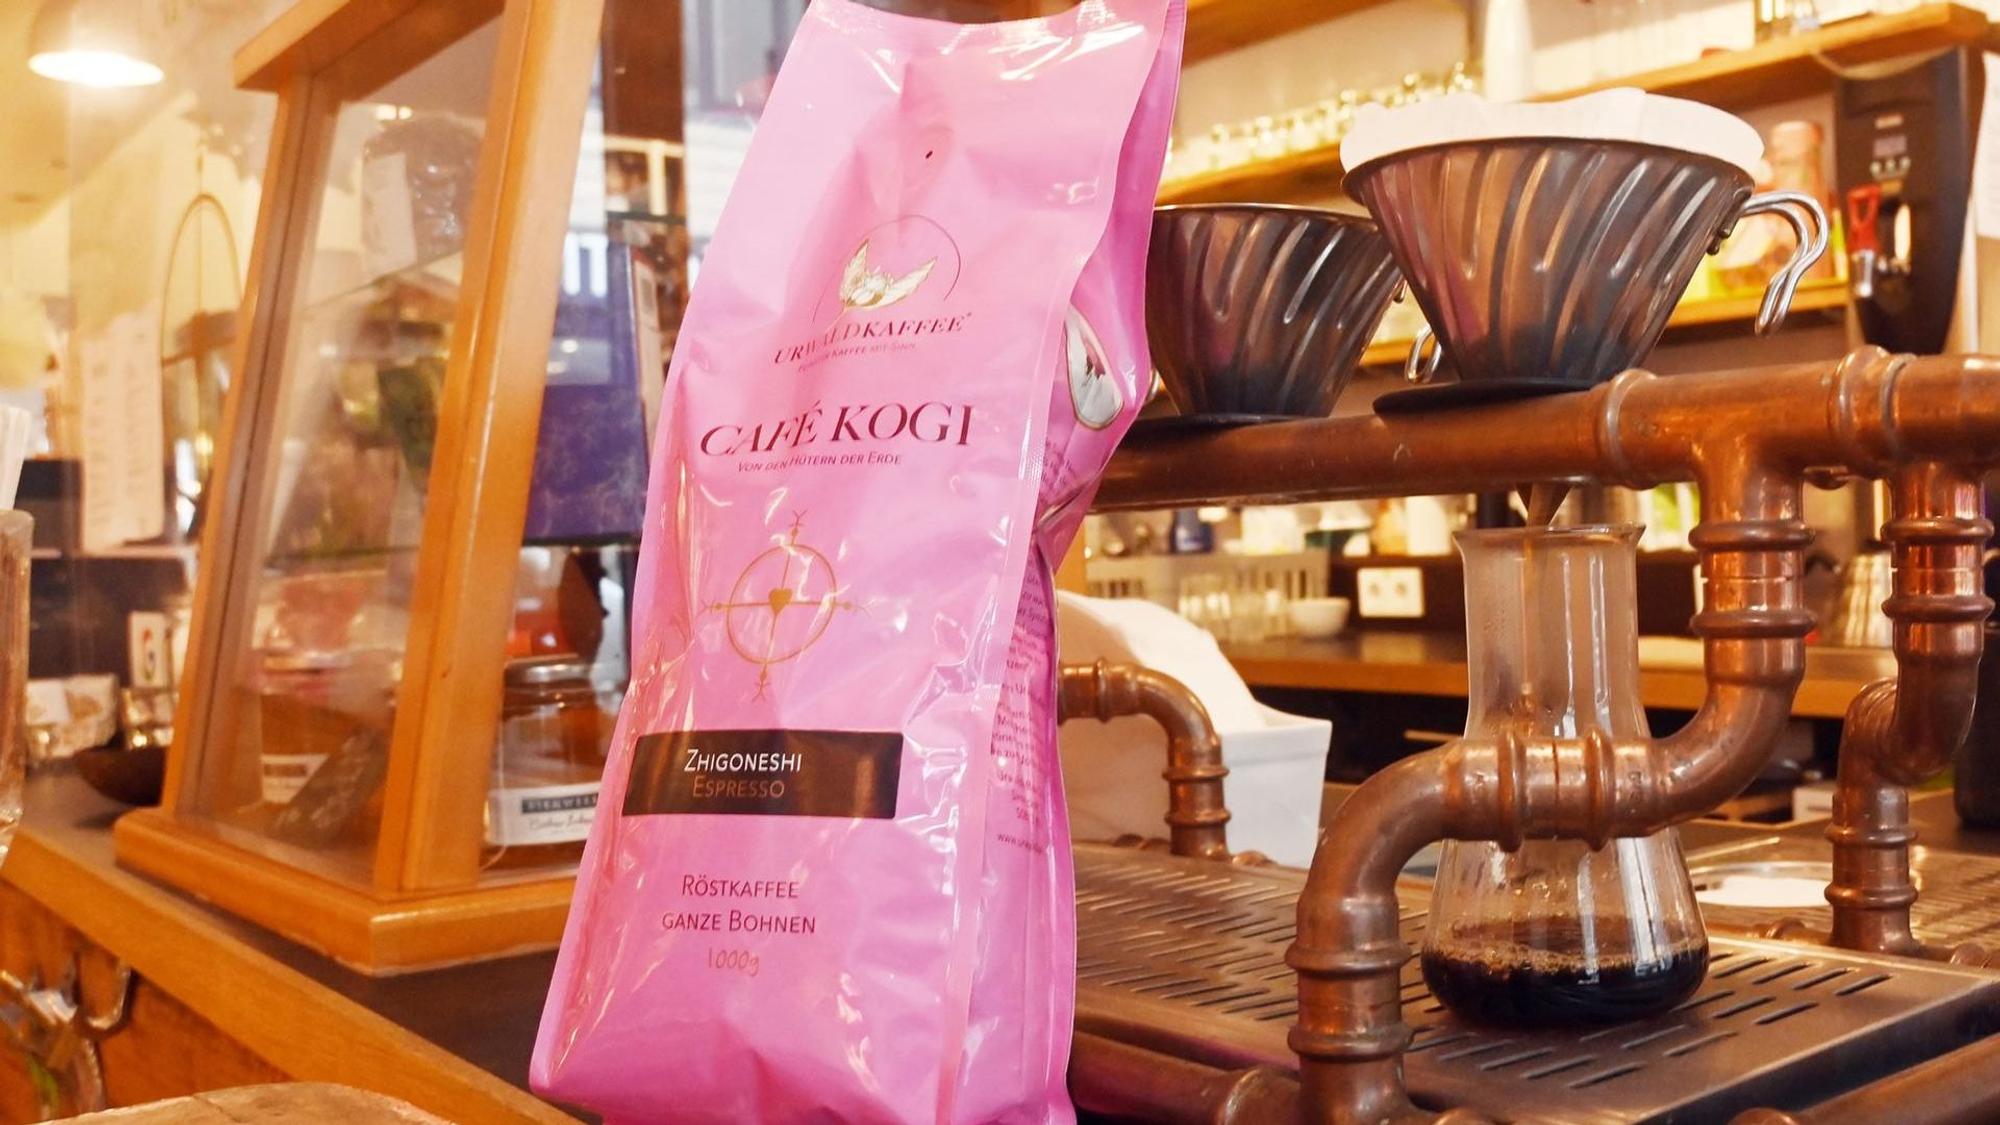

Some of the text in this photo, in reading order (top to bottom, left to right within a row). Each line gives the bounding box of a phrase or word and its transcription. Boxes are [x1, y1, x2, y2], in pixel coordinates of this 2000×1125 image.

[700, 400, 975, 457] CAFÉ KOGI
[737, 461, 762, 473] VON
[839, 453, 864, 465] DER
[867, 450, 902, 466] ERDE
[684, 748, 802, 773] ZHIGONESHI
[692, 775, 785, 798] ESPRESSO
[682, 874, 799, 899] RÖSTKAFFEE
[662, 909, 816, 934] GANZE BOHNEN
[708, 947, 760, 977] 1000g
